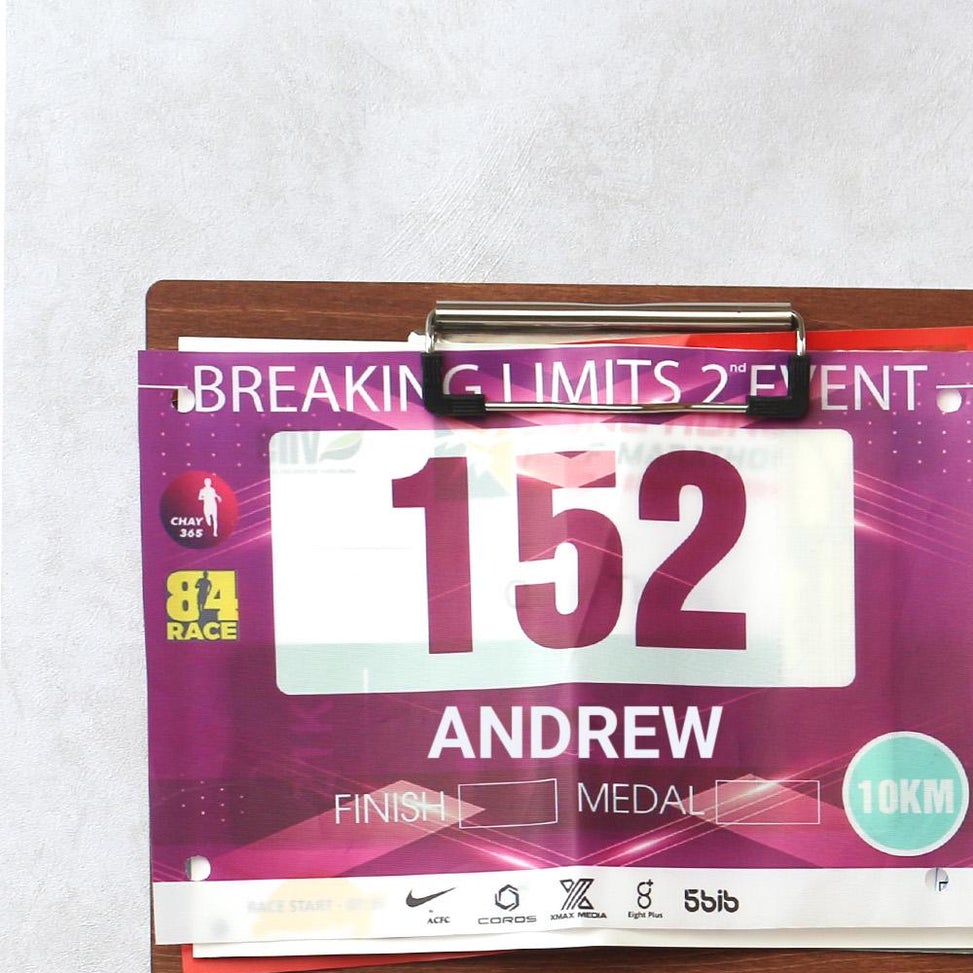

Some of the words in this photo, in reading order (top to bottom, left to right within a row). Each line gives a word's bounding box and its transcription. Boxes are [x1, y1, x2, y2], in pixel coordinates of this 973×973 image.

[170, 516, 204, 526] CHAY
[179, 528, 204, 538] 365
[391, 449, 747, 655] 152
[166, 570, 239, 622] 84
[167, 621, 237, 641] RACE
[427, 705, 724, 760] ANDREW
[335, 790, 447, 825] FINISH
[577, 782, 706, 816] MEDAL
[857, 778, 954, 816] 10KM
[684, 889, 740, 913] 5bib
[478, 915, 537, 925] COROS
[550, 912, 574, 921] XMAX
[577, 911, 607, 919] MEDIA
[628, 911, 646, 920] Eight
[648, 911, 663, 919] Plus
